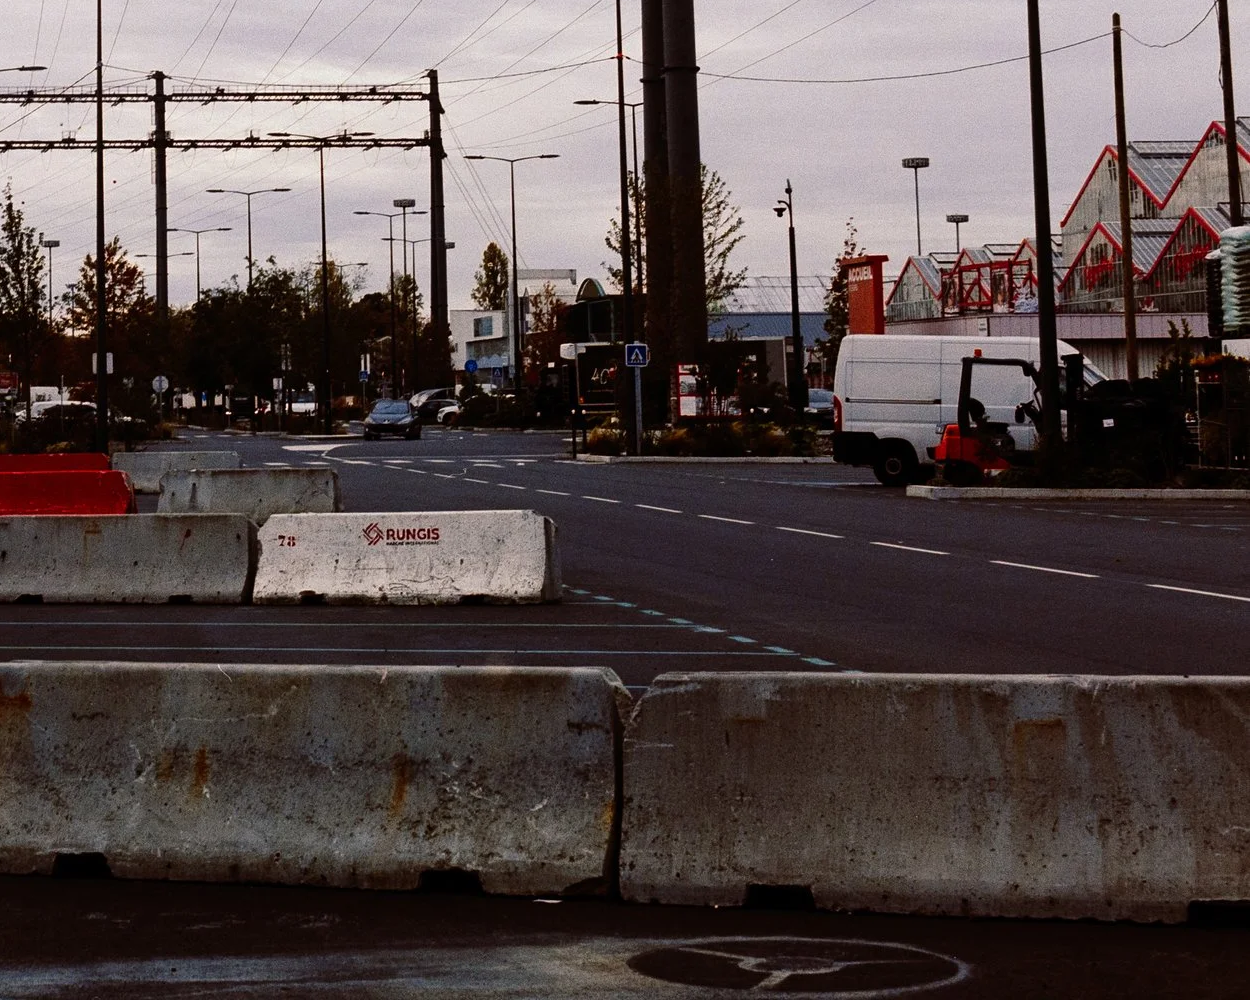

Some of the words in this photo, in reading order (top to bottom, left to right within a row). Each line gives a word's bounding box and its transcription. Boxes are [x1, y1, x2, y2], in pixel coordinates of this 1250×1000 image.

[848, 265, 873, 282] ACCUEIL
[278, 534, 296, 547] 78
[386, 528, 439, 540] RUNGIS
